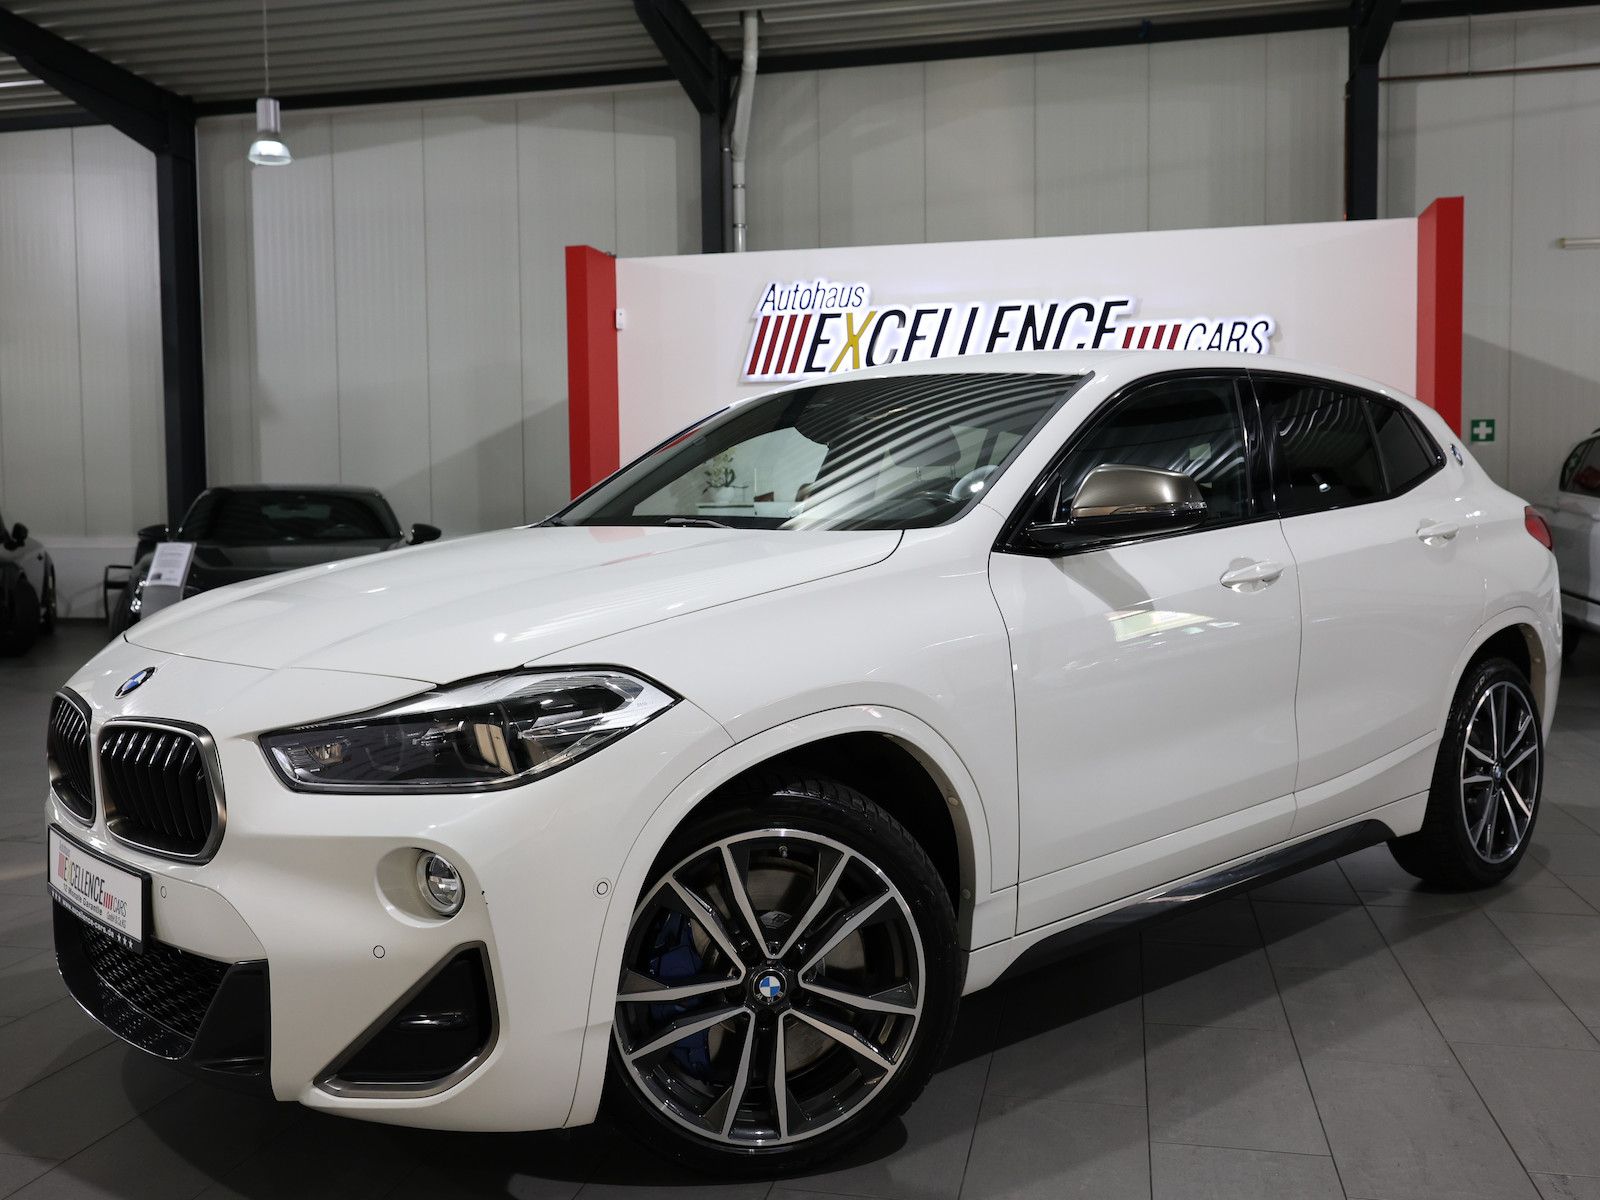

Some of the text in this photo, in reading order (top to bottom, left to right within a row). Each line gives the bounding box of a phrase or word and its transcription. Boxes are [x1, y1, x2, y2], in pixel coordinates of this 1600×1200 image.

[760, 281, 865, 312] Autohaus
[803, 299, 1270, 373] EXCELLENCE CARS
[63, 856, 128, 918] EXCELLENCE CARS
